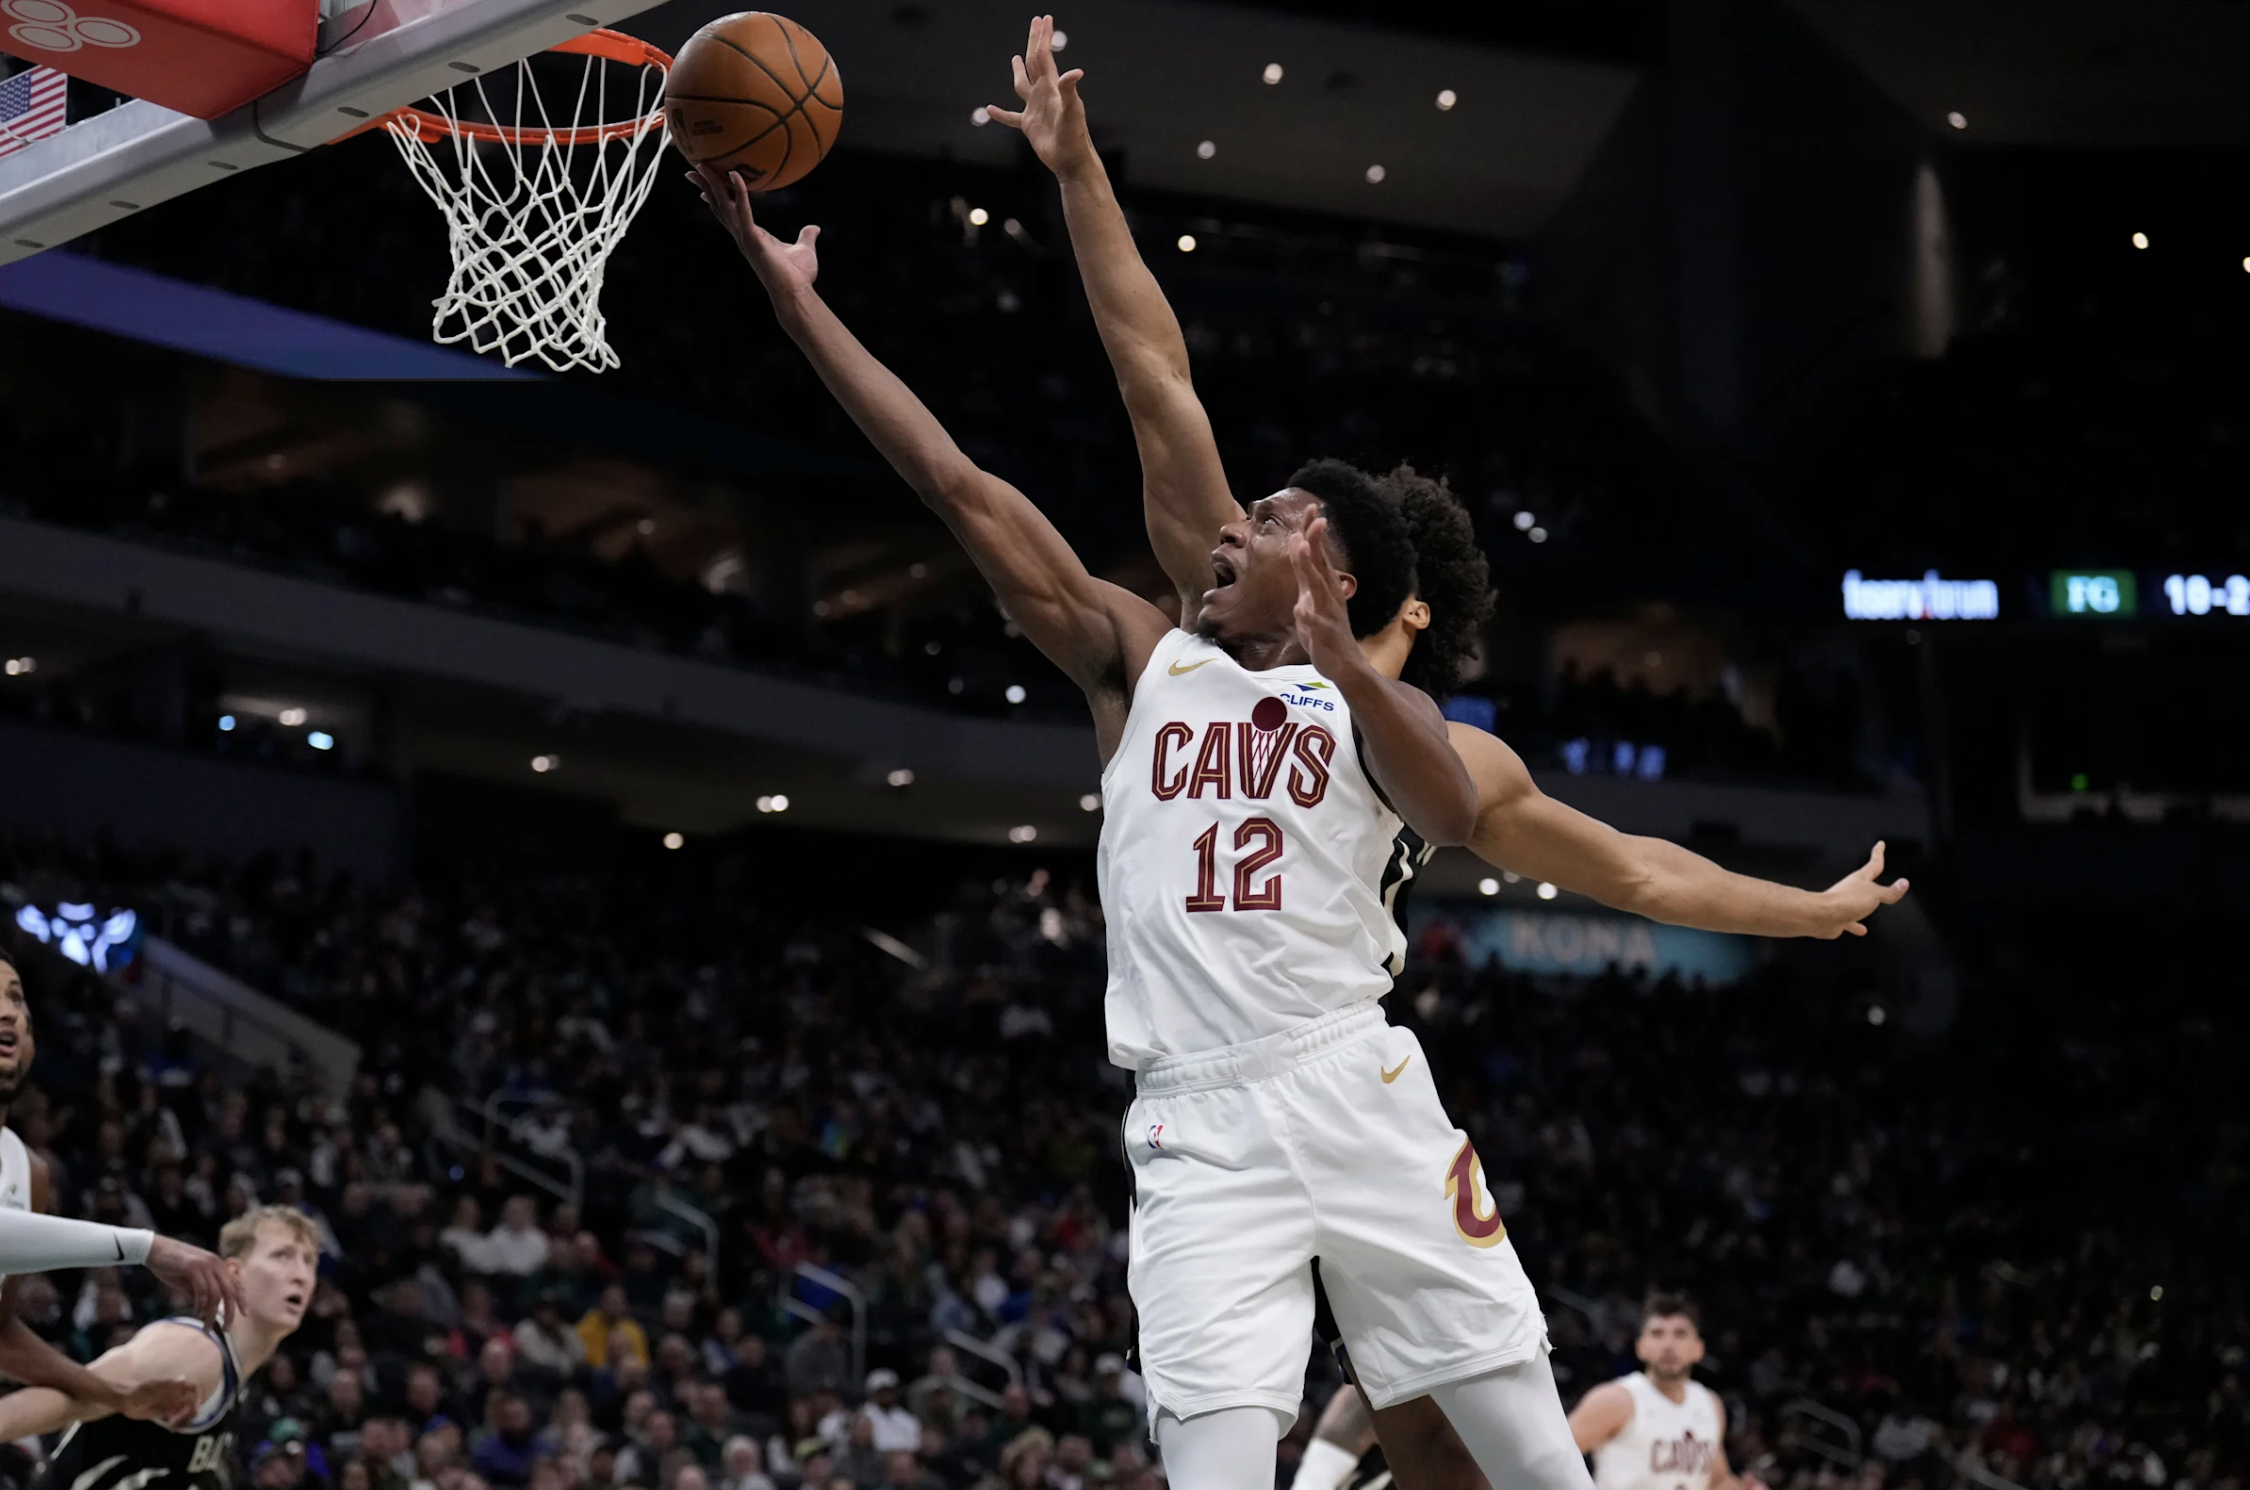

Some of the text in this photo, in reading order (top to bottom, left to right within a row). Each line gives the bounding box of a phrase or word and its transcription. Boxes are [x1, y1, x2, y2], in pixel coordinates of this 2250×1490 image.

[1151, 718, 1337, 809] CAVS
[1185, 817, 1284, 913] 12
[1511, 915, 1657, 968] KONA
